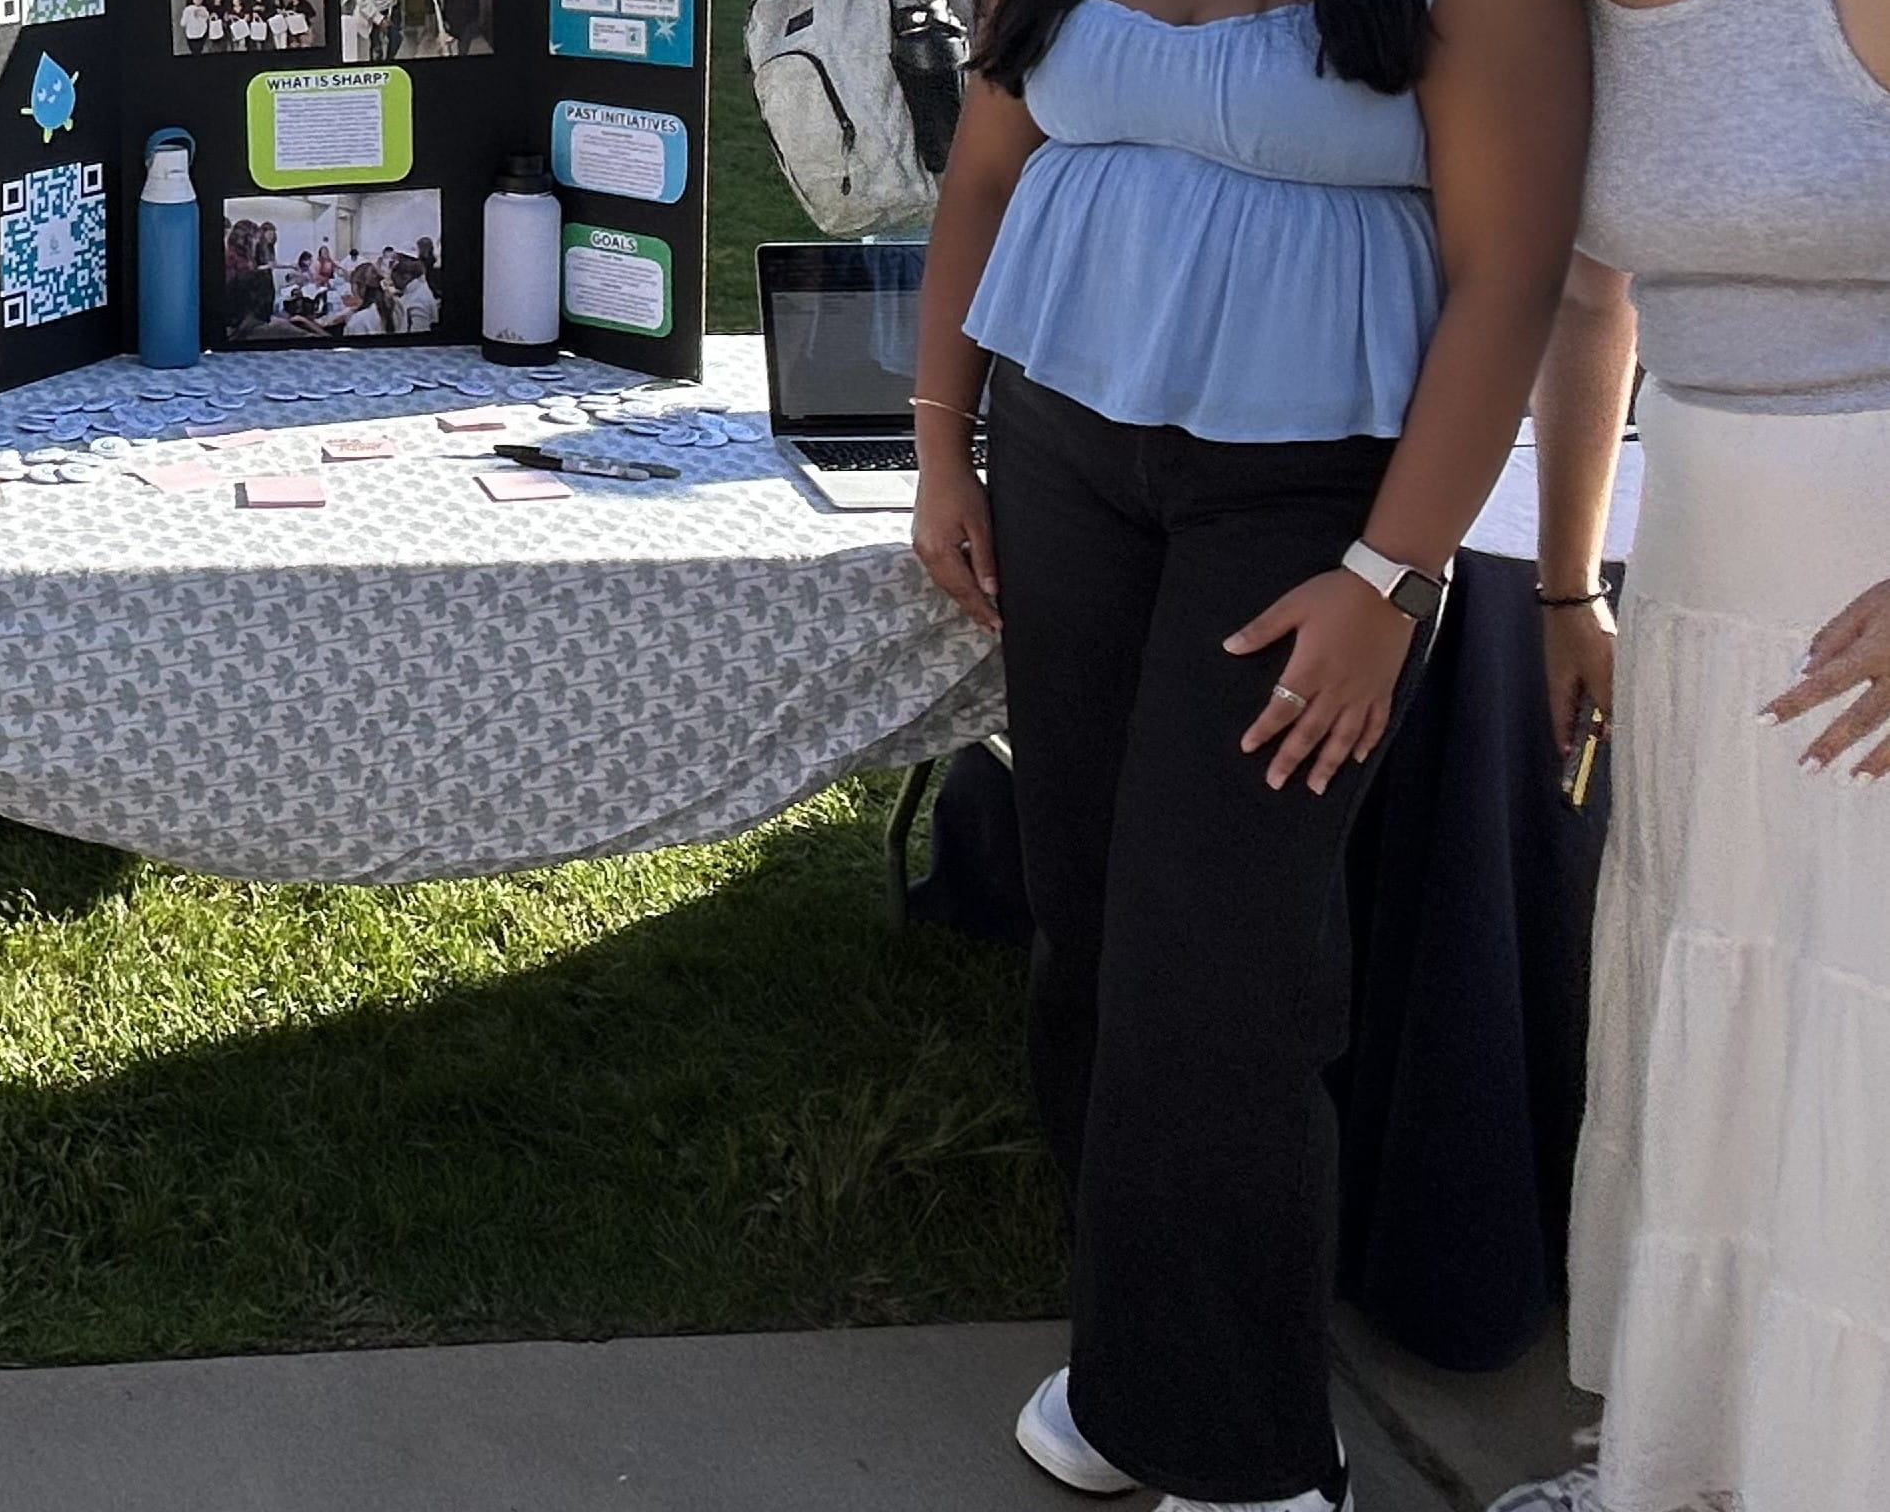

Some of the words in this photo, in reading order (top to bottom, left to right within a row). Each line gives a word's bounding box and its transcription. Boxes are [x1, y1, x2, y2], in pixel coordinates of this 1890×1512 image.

[267, 76, 311, 91] WHAT
[315, 76, 329, 88] IS
[332, 72, 390, 87] SHARP?
[567, 106, 598, 120] PAST
[600, 111, 677, 133] INITIATIVES
[592, 233, 636, 251] GOALS
